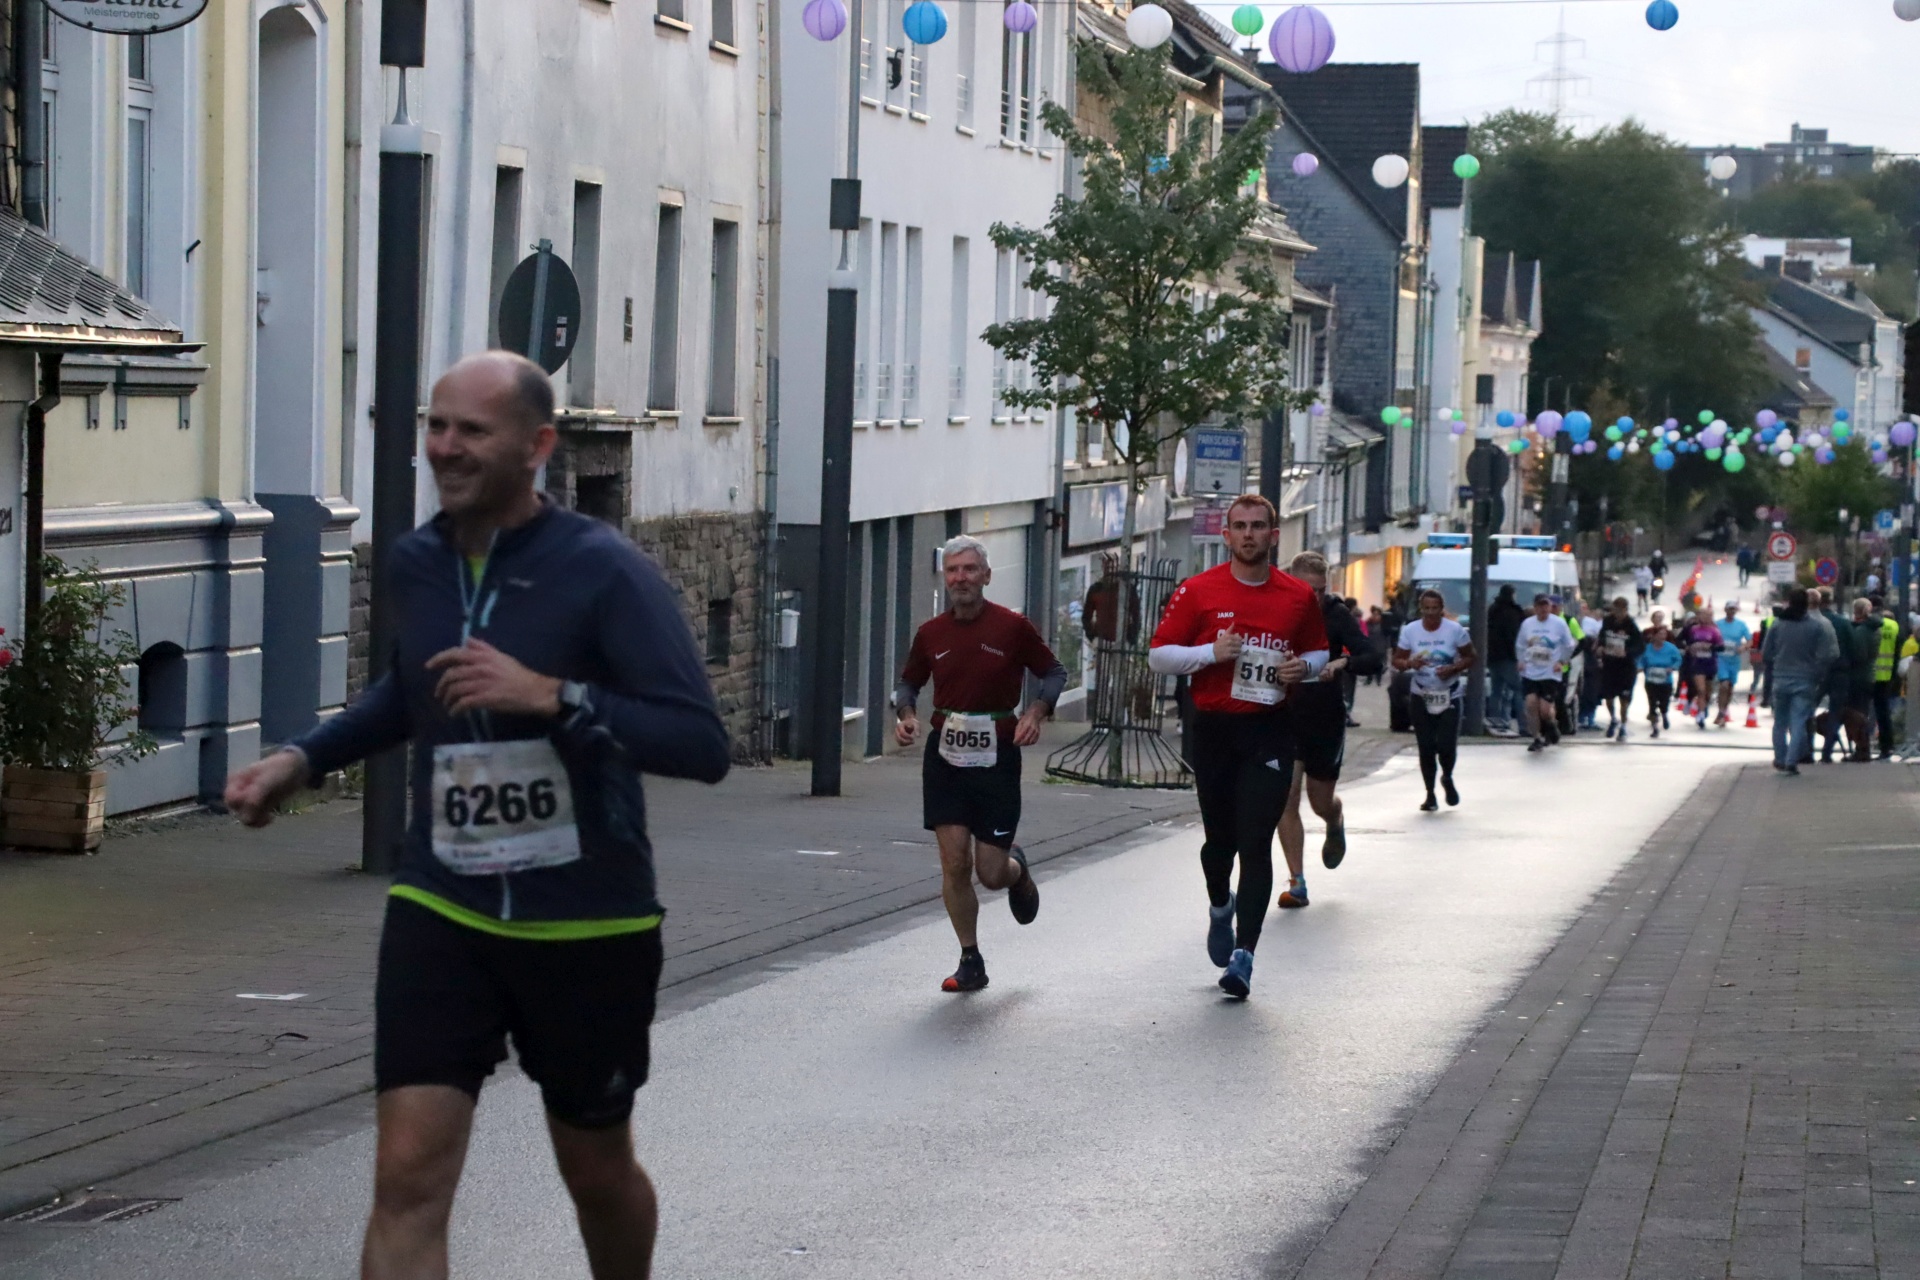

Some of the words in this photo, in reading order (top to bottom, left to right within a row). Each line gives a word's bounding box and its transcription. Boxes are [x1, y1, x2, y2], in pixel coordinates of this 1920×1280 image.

[84, 6, 160, 20] Meisterbetrieb
[1217, 611, 1235, 619] JAKO
[981, 643, 1004, 657] Thomas
[945, 728, 991, 749] 5055
[445, 778, 557, 828] 6266
